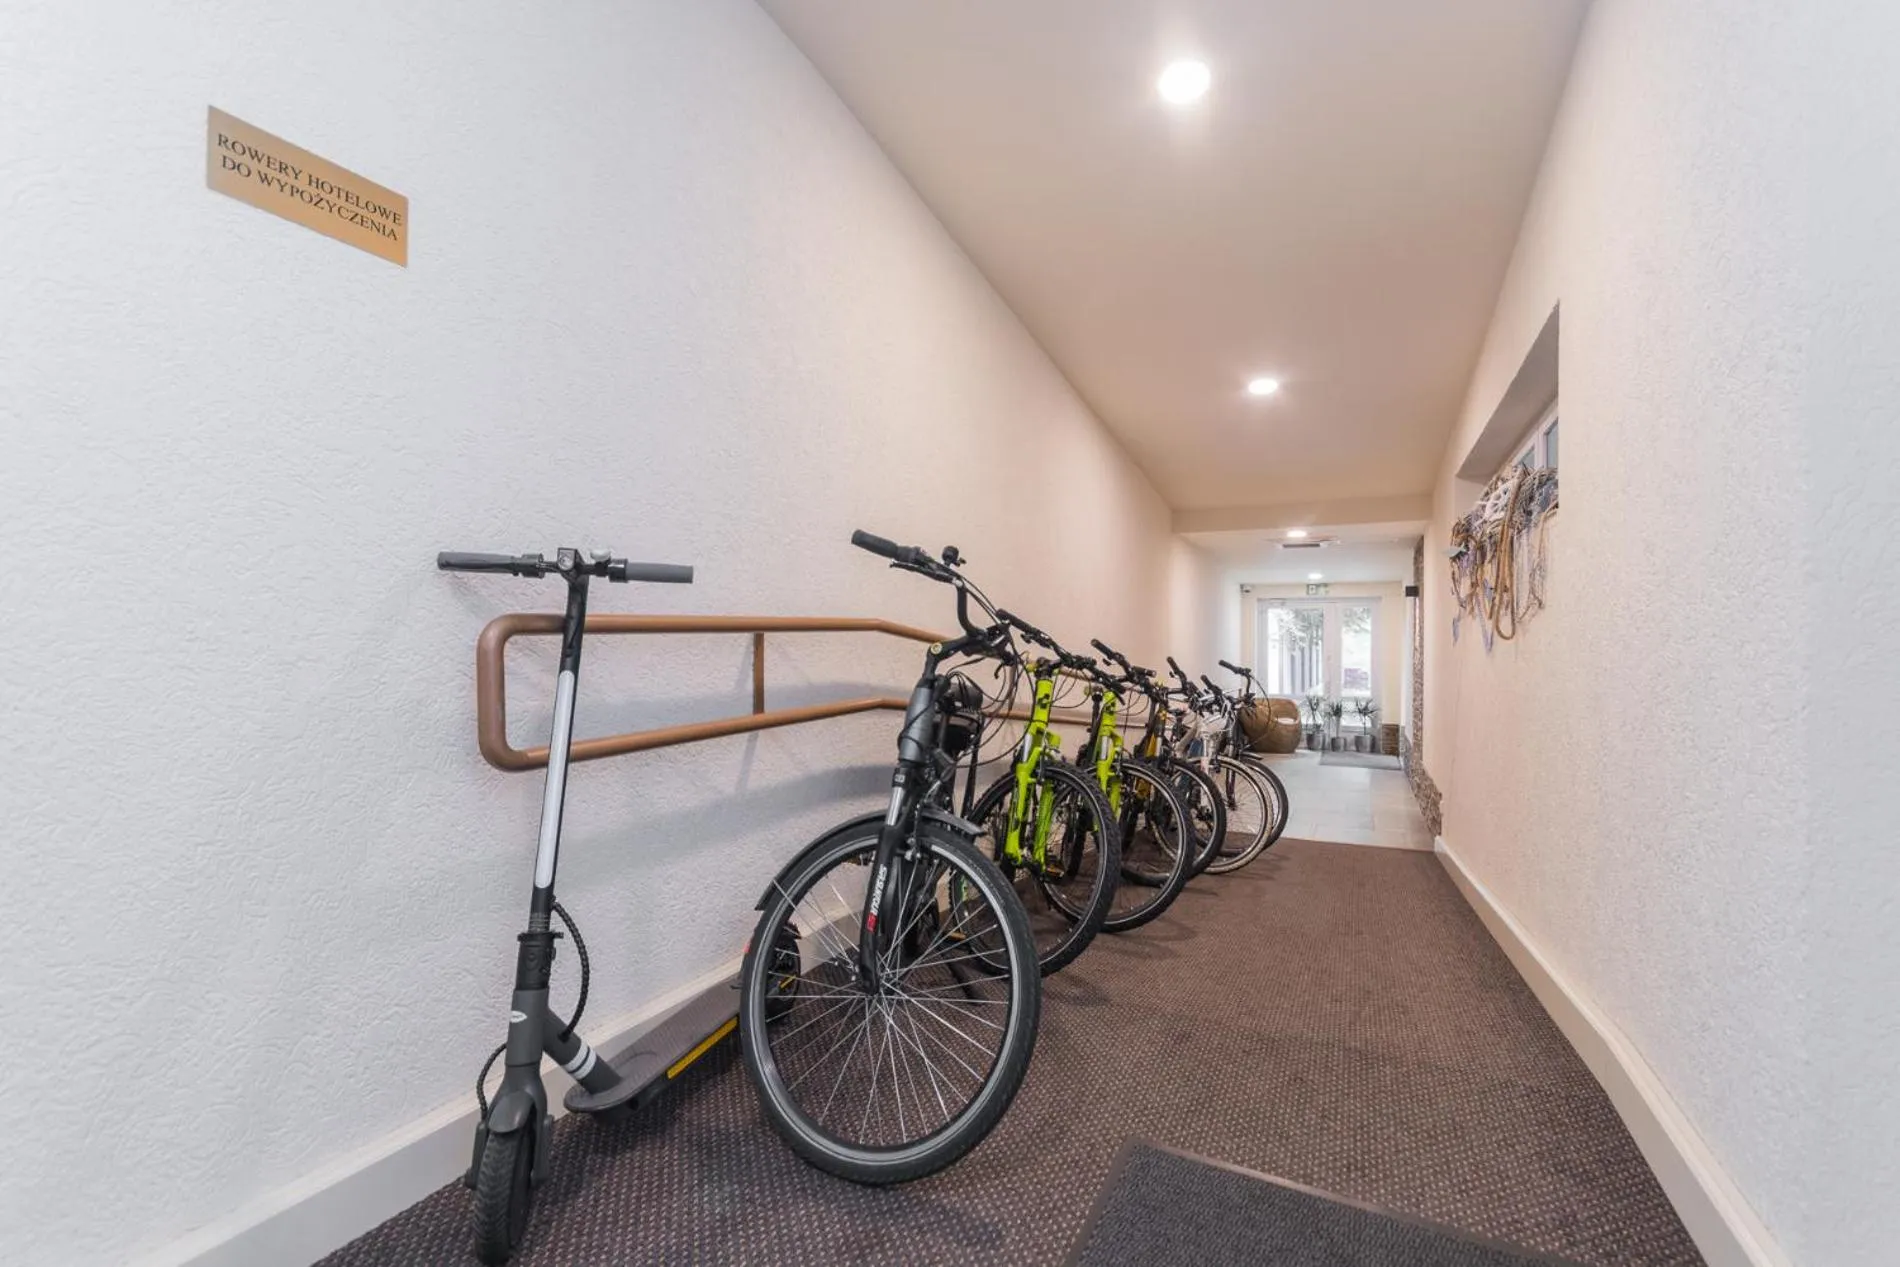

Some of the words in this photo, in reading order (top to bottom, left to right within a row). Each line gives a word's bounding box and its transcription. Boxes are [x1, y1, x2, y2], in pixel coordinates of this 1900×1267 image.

[217, 133, 302, 180] ROWERY
[307, 173, 402, 226] HOTELOWE
[221, 154, 252, 178] DO
